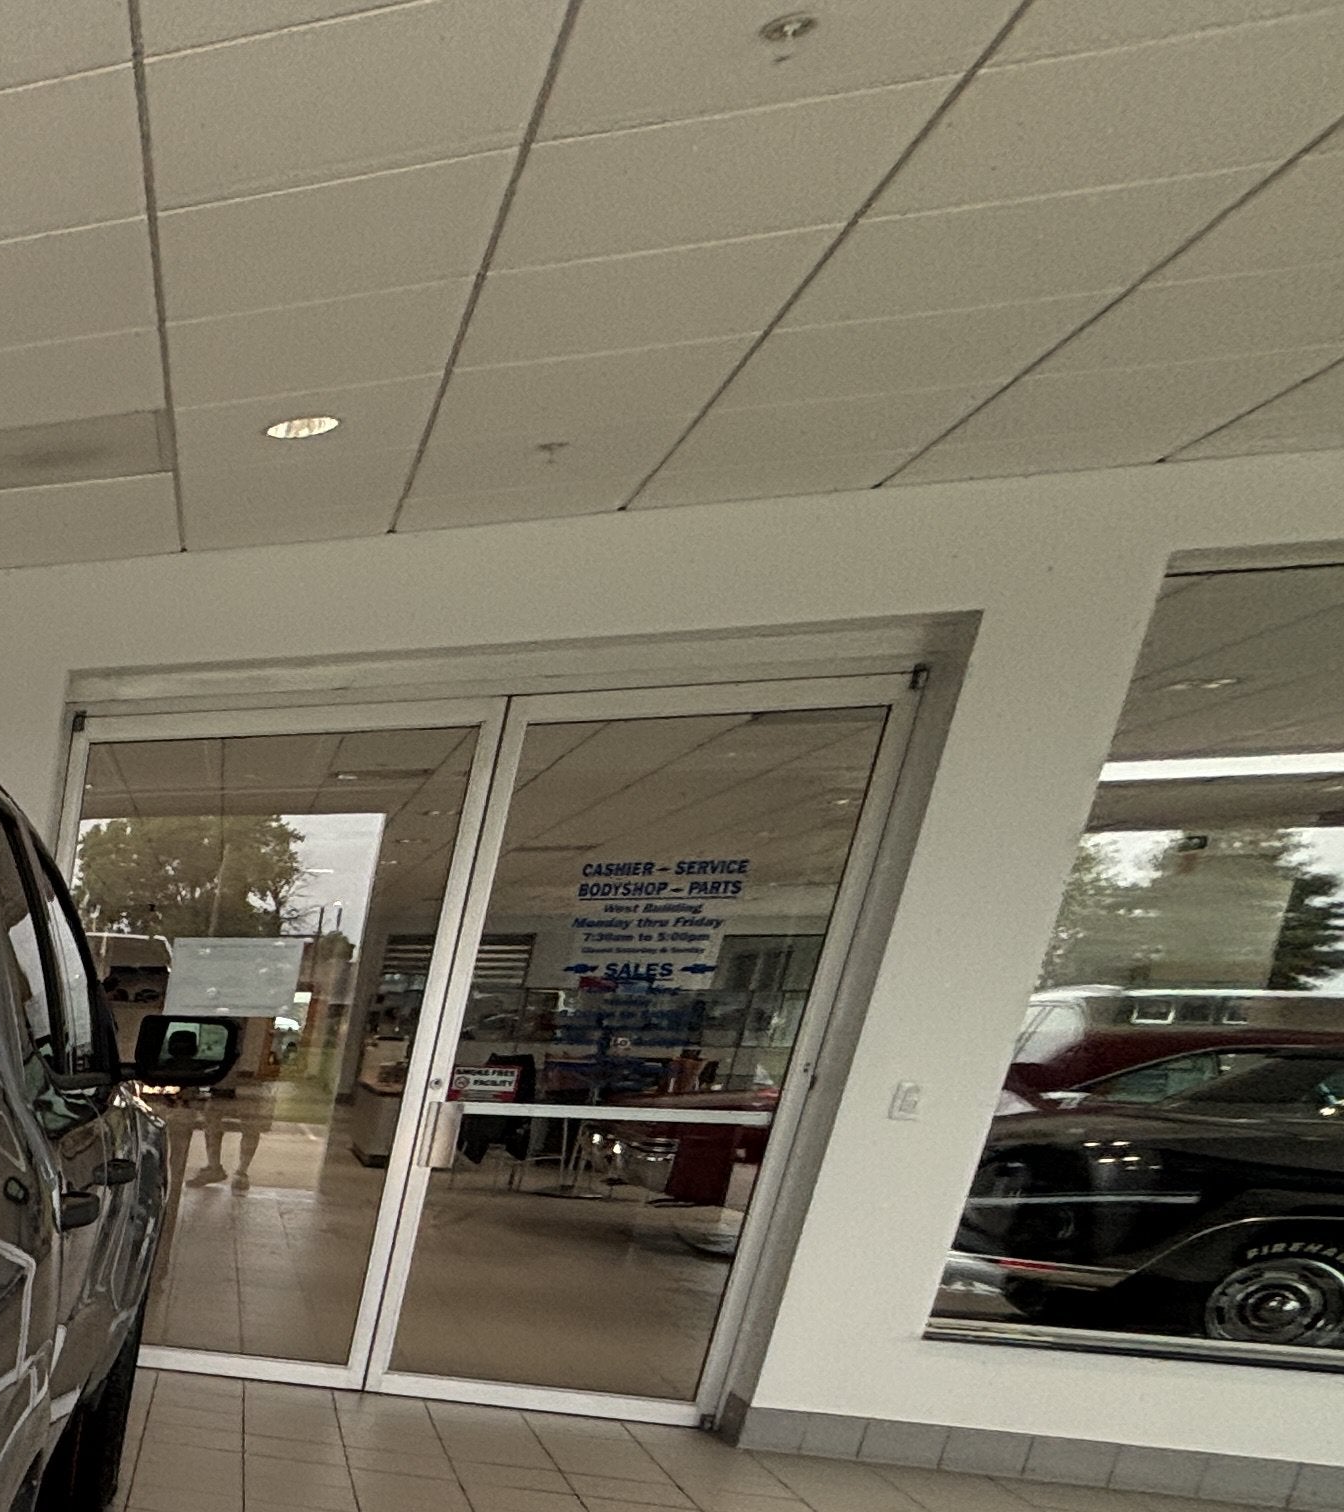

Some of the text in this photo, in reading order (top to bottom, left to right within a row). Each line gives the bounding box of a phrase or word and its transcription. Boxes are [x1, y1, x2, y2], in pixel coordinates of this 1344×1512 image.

[582, 858, 750, 877] CASHIER SERVICE
[578, 880, 743, 898] BODYSHOP PARTS
[570, 916, 724, 930] Monday thru Friday
[638, 932, 653, 942] to
[603, 962, 674, 978] SALES
